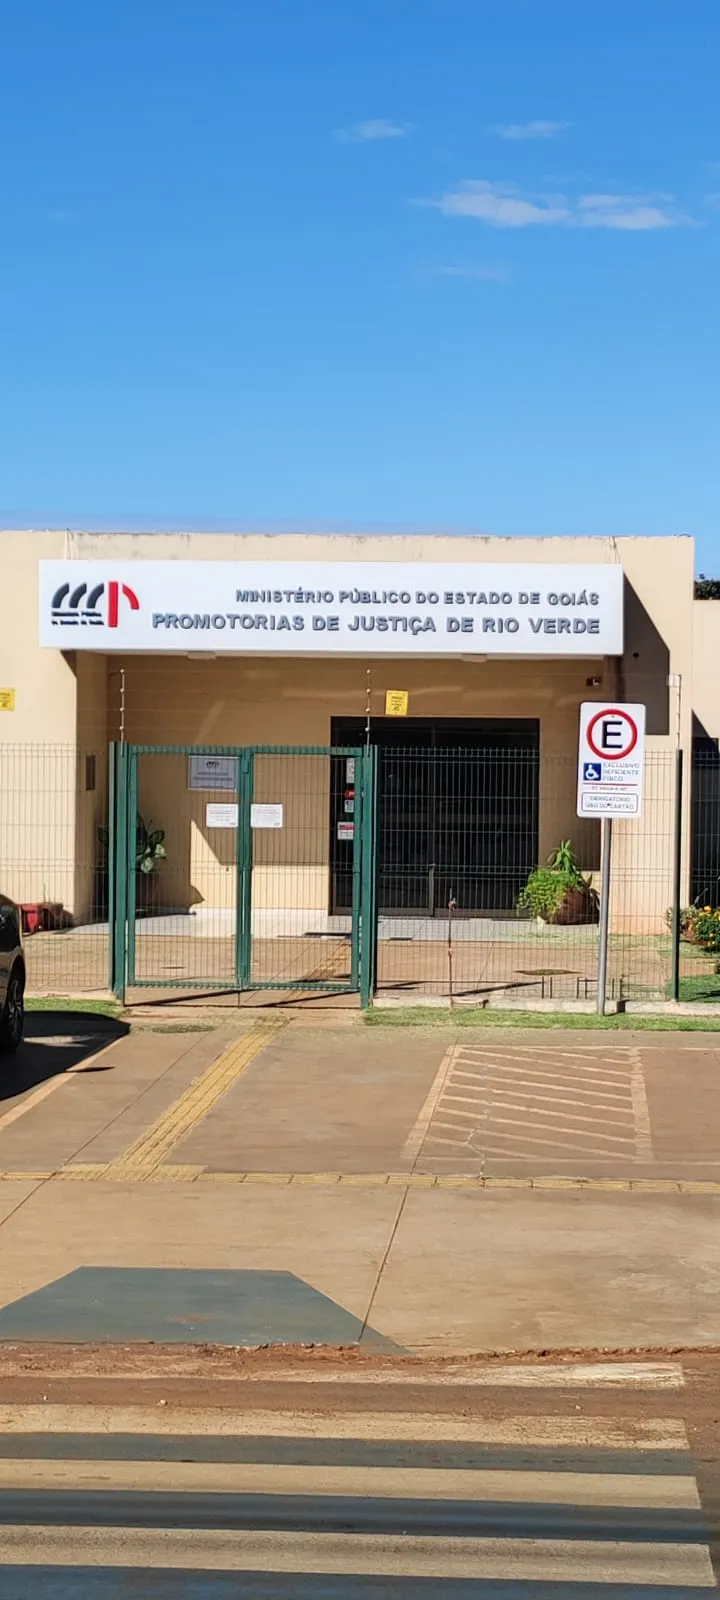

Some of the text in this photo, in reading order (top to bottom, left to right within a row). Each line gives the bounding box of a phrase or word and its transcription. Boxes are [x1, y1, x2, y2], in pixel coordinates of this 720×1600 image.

[235, 586, 600, 606] MINISTÉRIO PÚBLICO DO ESTADO DE GOIÁS
[151, 612, 600, 635] PROMOTORIAS DE JUSTIÇA DE RIO VERDE
[602, 720, 624, 749] E
